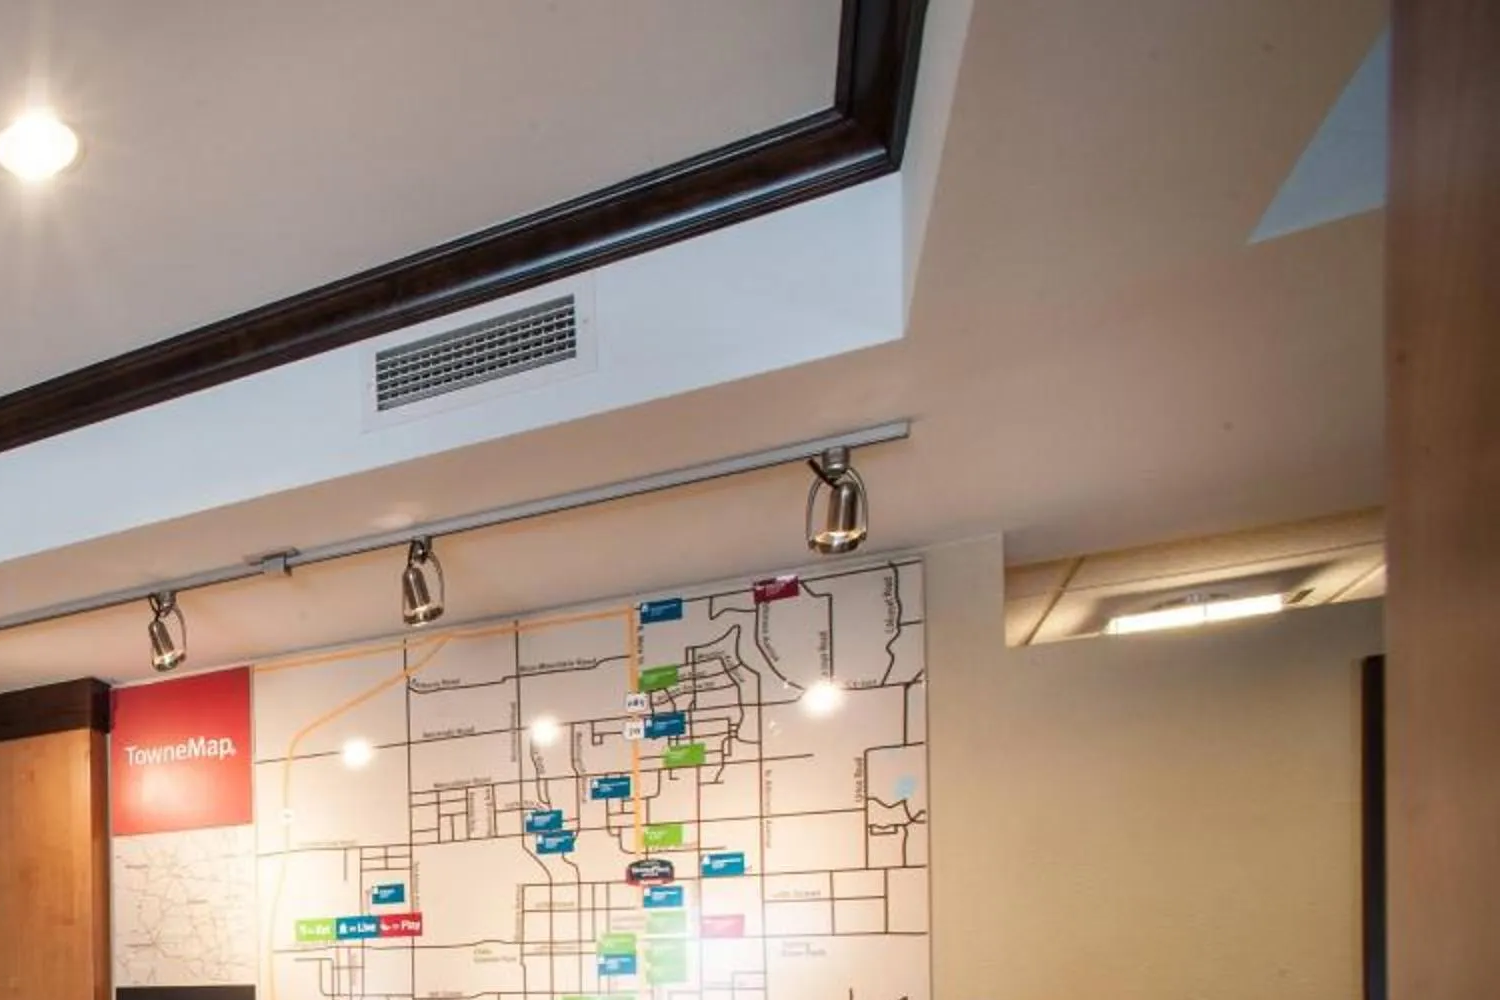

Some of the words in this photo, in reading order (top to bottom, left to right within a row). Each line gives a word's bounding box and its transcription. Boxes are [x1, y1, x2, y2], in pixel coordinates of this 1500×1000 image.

[124, 735, 232, 767] TowneMap
[357, 922, 377, 933] Live
[401, 920, 421, 932] Play
